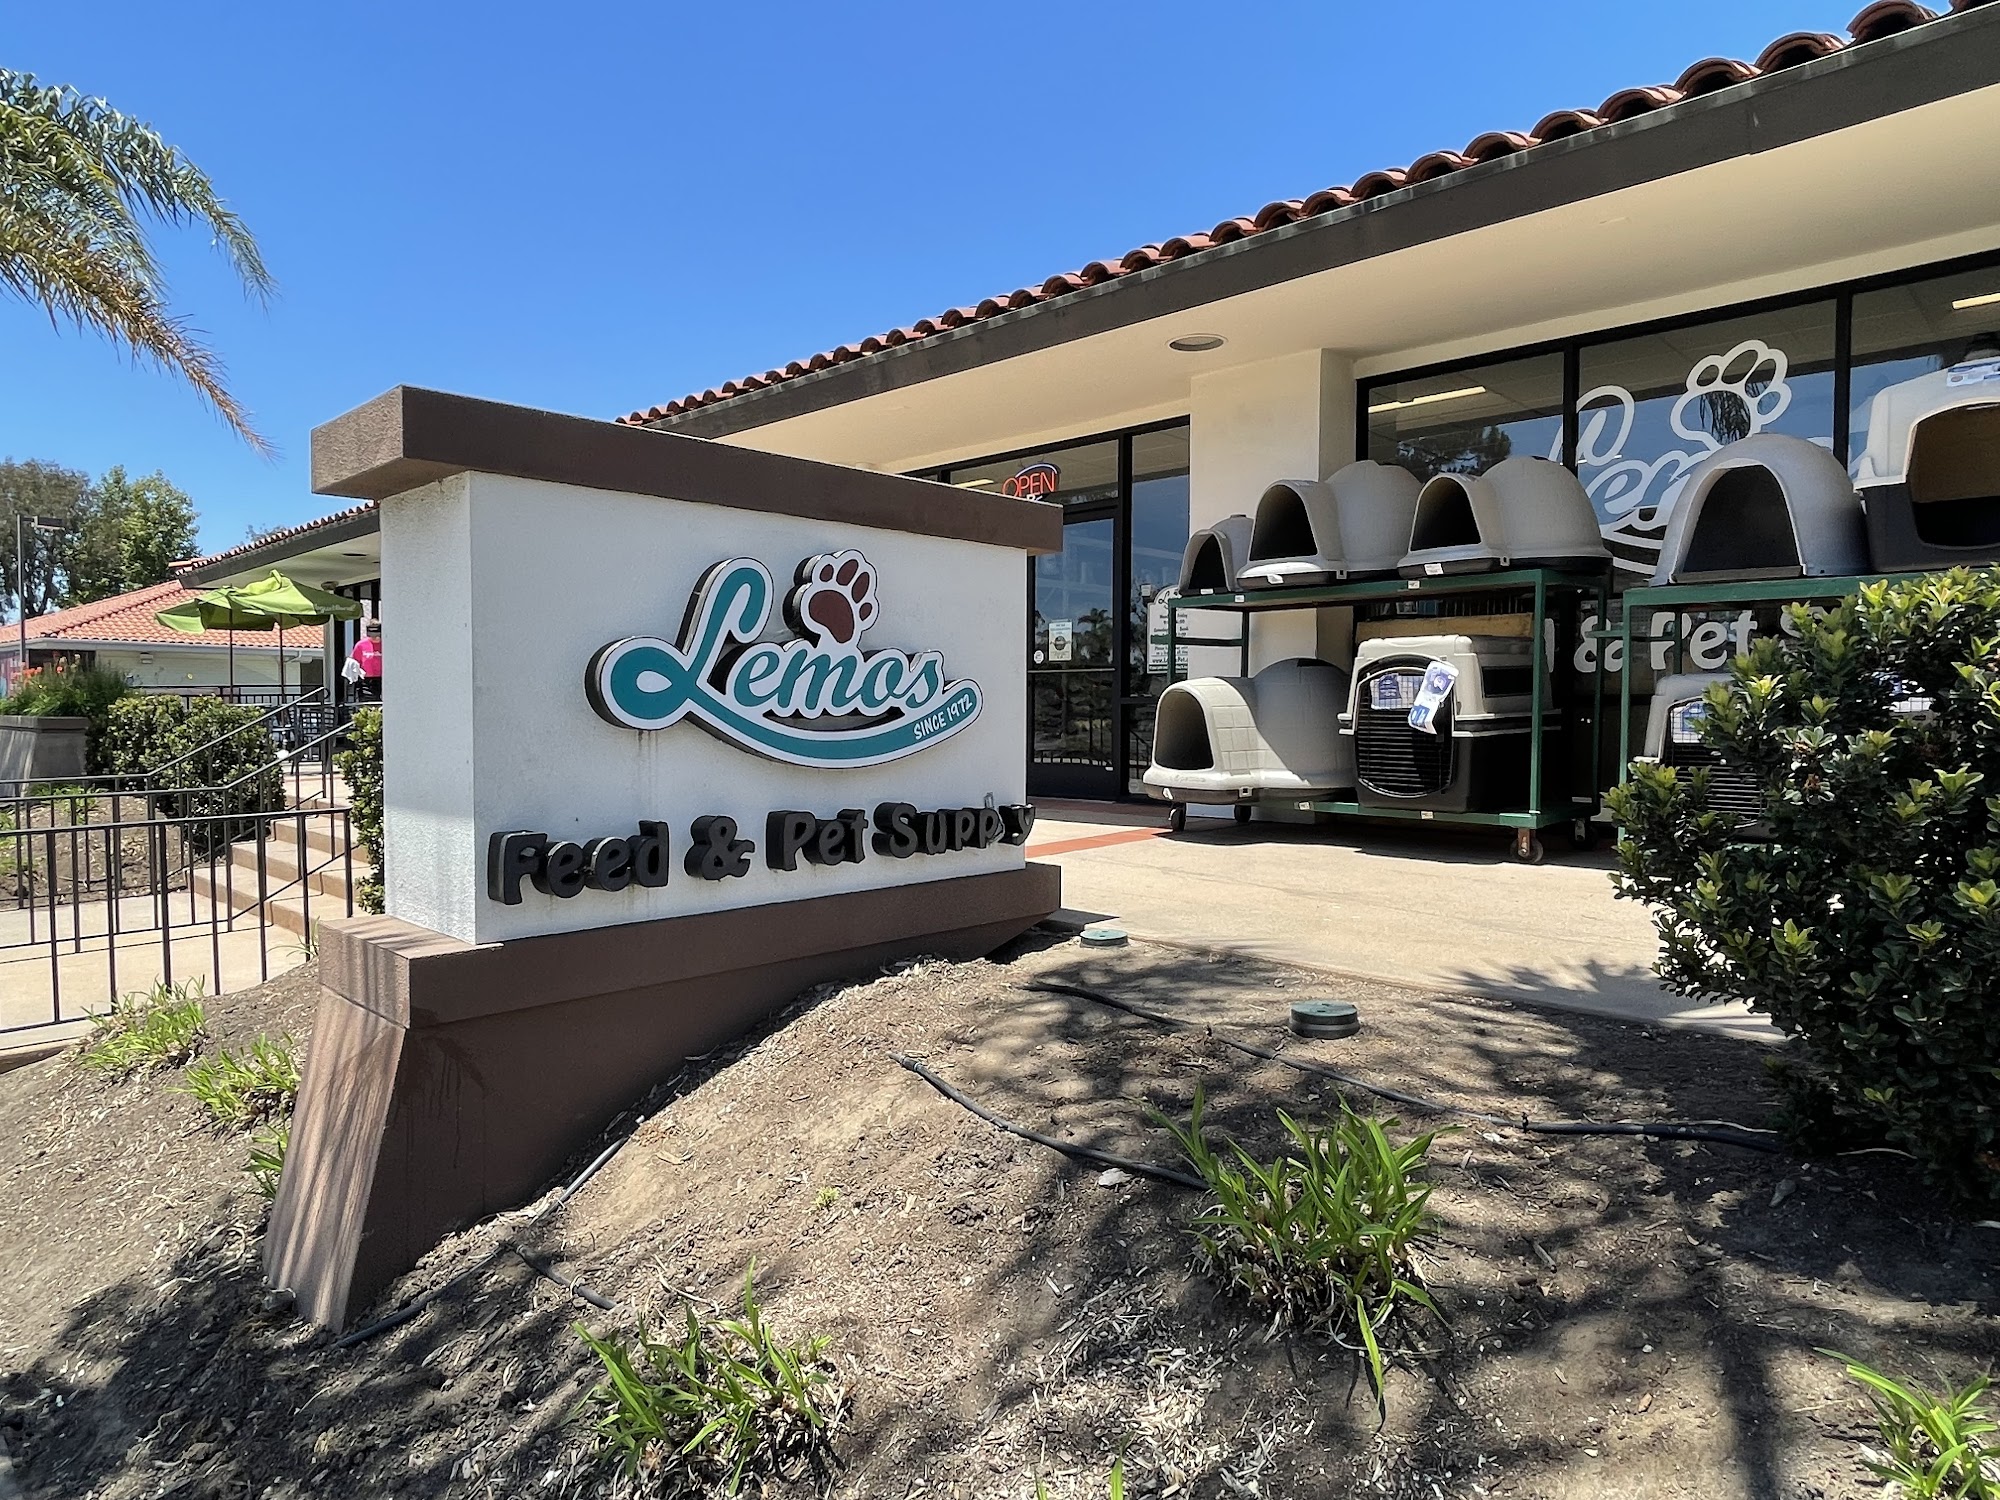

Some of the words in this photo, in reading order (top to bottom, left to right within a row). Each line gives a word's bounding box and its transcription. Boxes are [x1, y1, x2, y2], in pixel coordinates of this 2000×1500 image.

[1002, 470, 1055, 498] OPEN
[611, 567, 977, 759] Lemos
[1650, 610, 1757, 671] Pet
[913, 711, 947, 740] SINCE
[946, 694, 973, 721] 1972
[488, 820, 670, 905] Feed
[684, 815, 755, 881] &
[767, 808, 868, 872] Pet
[873, 802, 1036, 859] Suppy
